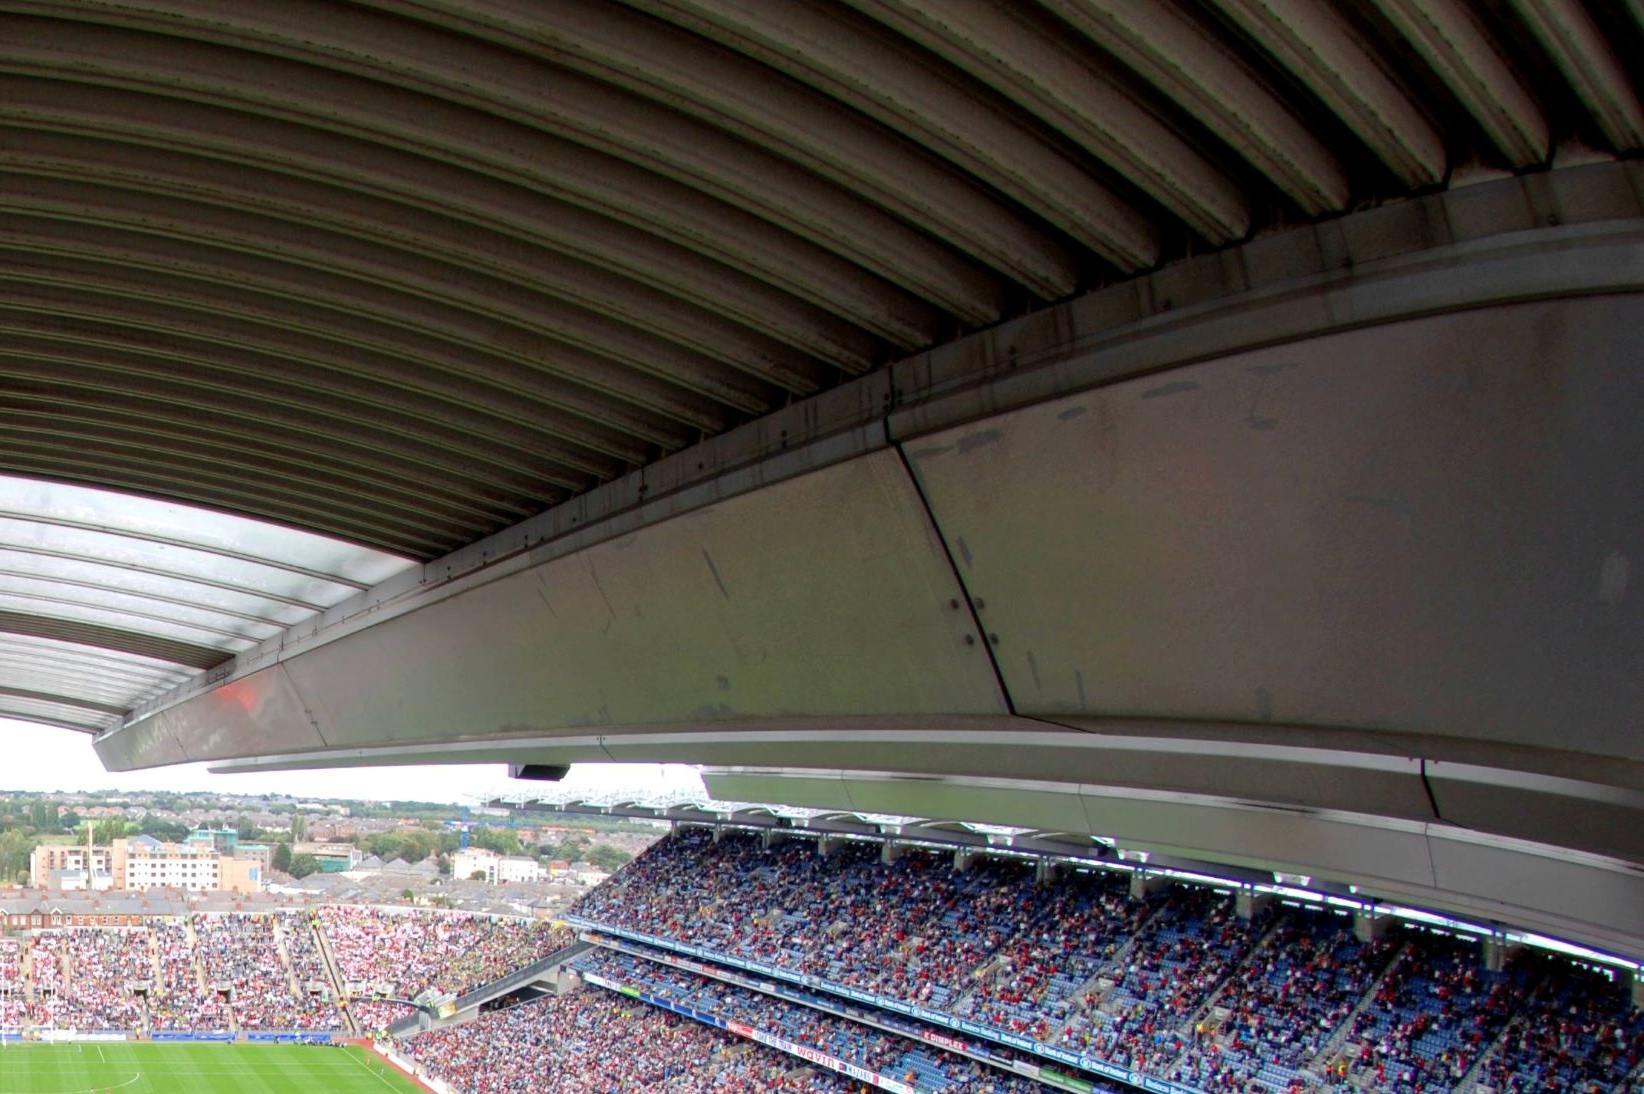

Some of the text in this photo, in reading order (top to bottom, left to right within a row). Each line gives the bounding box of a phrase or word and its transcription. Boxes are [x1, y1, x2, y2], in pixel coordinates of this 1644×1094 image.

[929, 1031, 964, 1051] DIMPLEX
[797, 1047, 836, 1069] wavin
[847, 1064, 872, 1080] MAZARS
[1091, 1062, 1105, 1072] Bank
[1110, 1068, 1129, 1080] Ireland
